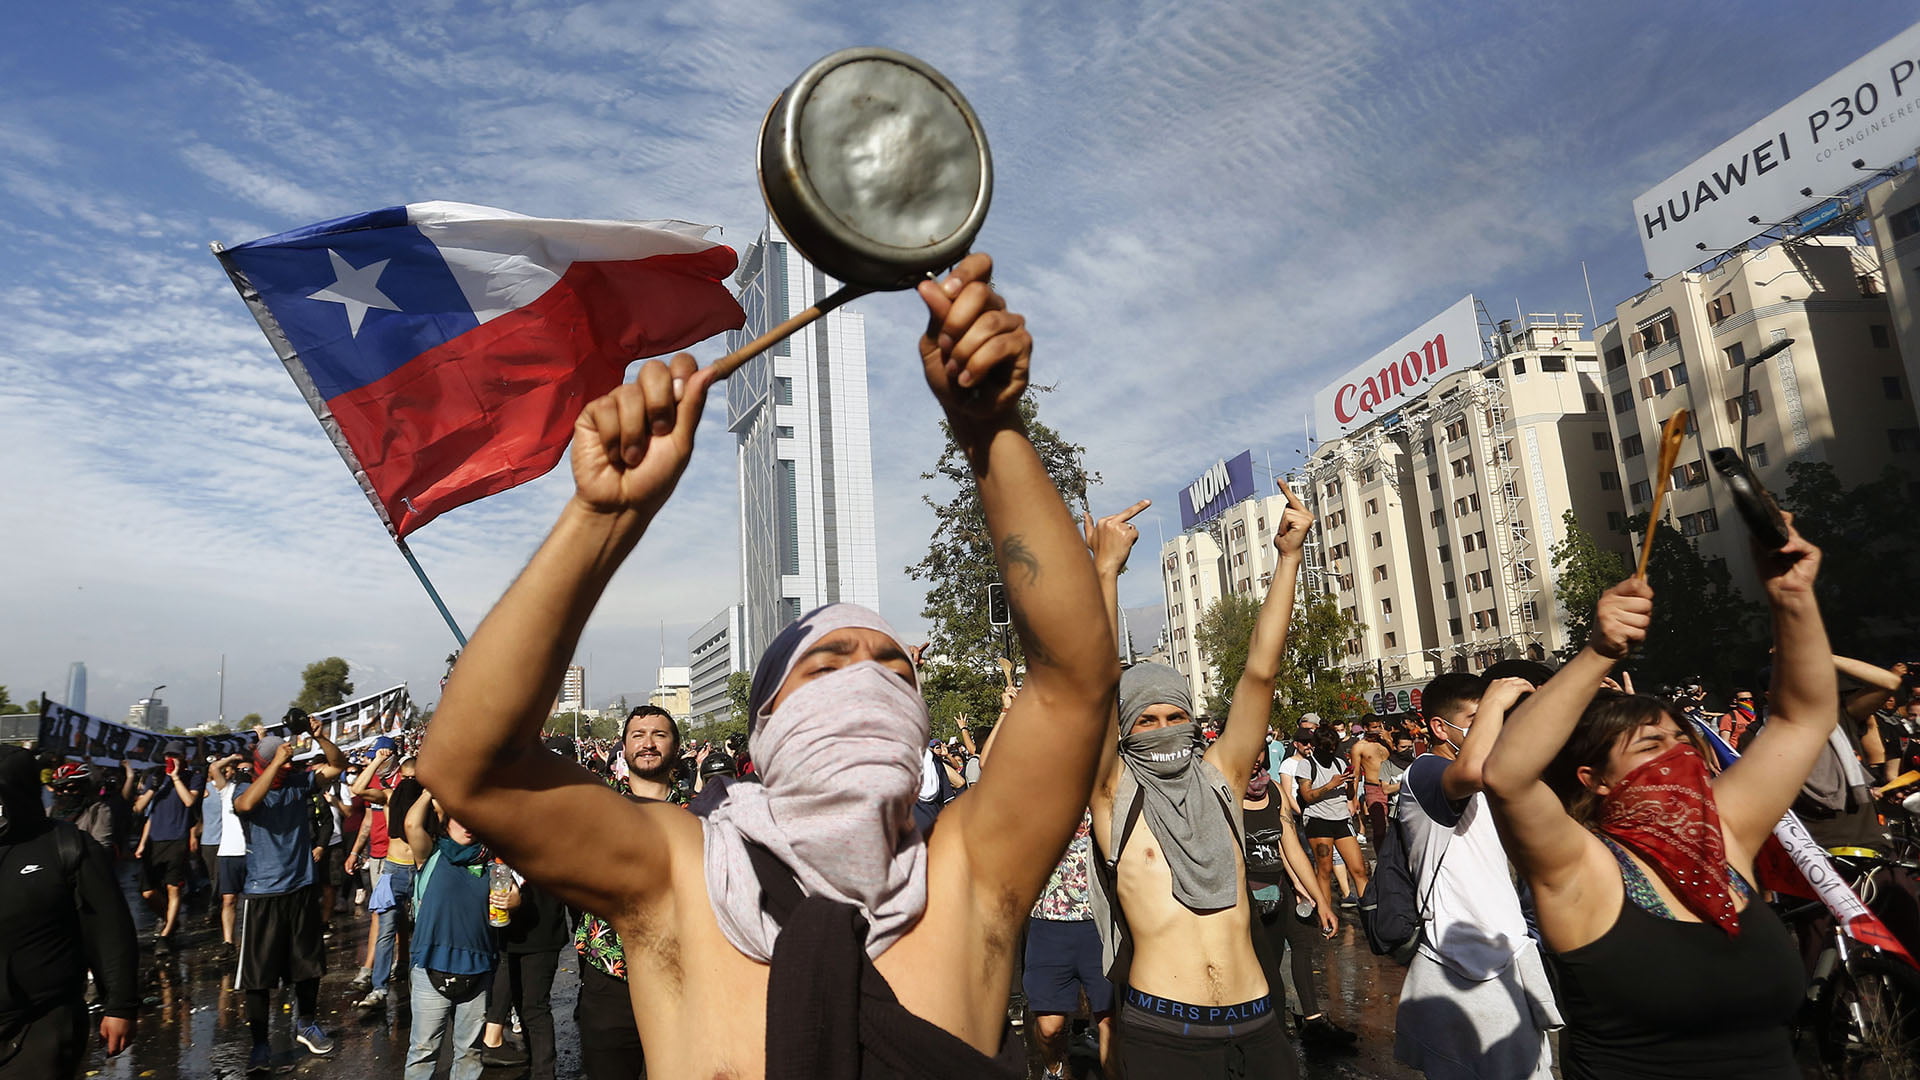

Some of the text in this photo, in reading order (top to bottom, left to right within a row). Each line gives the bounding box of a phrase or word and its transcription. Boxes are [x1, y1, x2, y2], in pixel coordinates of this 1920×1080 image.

[1644, 60, 1920, 239] HUAWEI P30 P
[1334, 333, 1449, 424] Canon
[1189, 458, 1231, 514] WOM
[1150, 751, 1177, 762] WHAT
